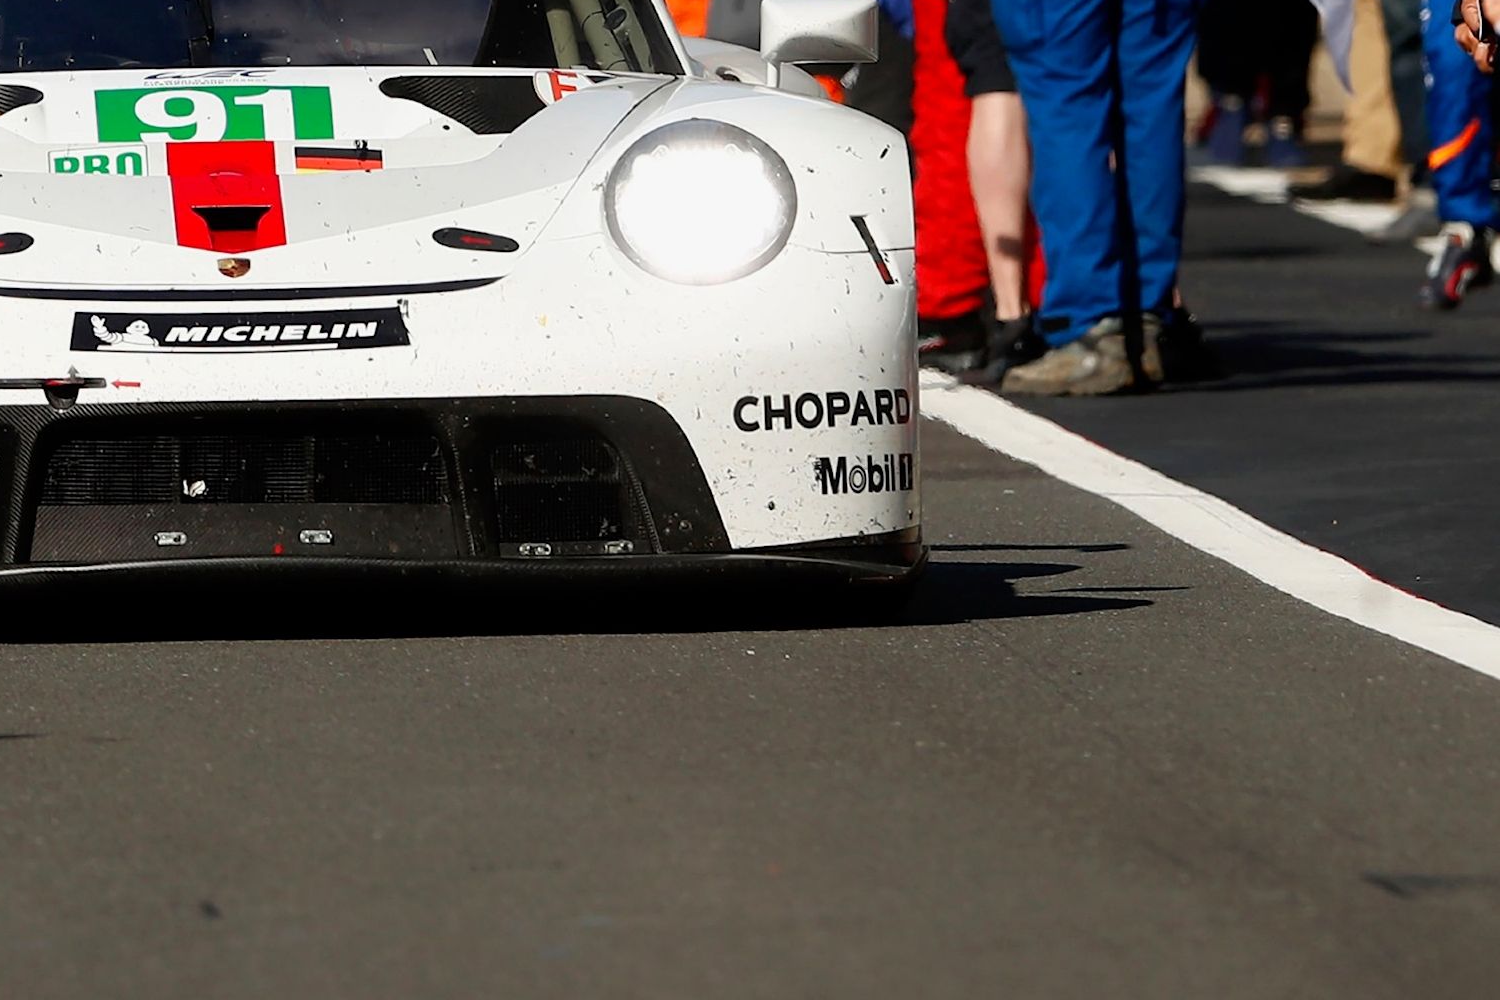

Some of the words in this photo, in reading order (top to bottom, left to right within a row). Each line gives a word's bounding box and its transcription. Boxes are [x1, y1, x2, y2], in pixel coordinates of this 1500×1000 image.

[133, 89, 297, 143] 91
[164, 320, 378, 343] MICHELIN
[732, 387, 911, 433] CHOPARD
[819, 453, 897, 495] Mobil
